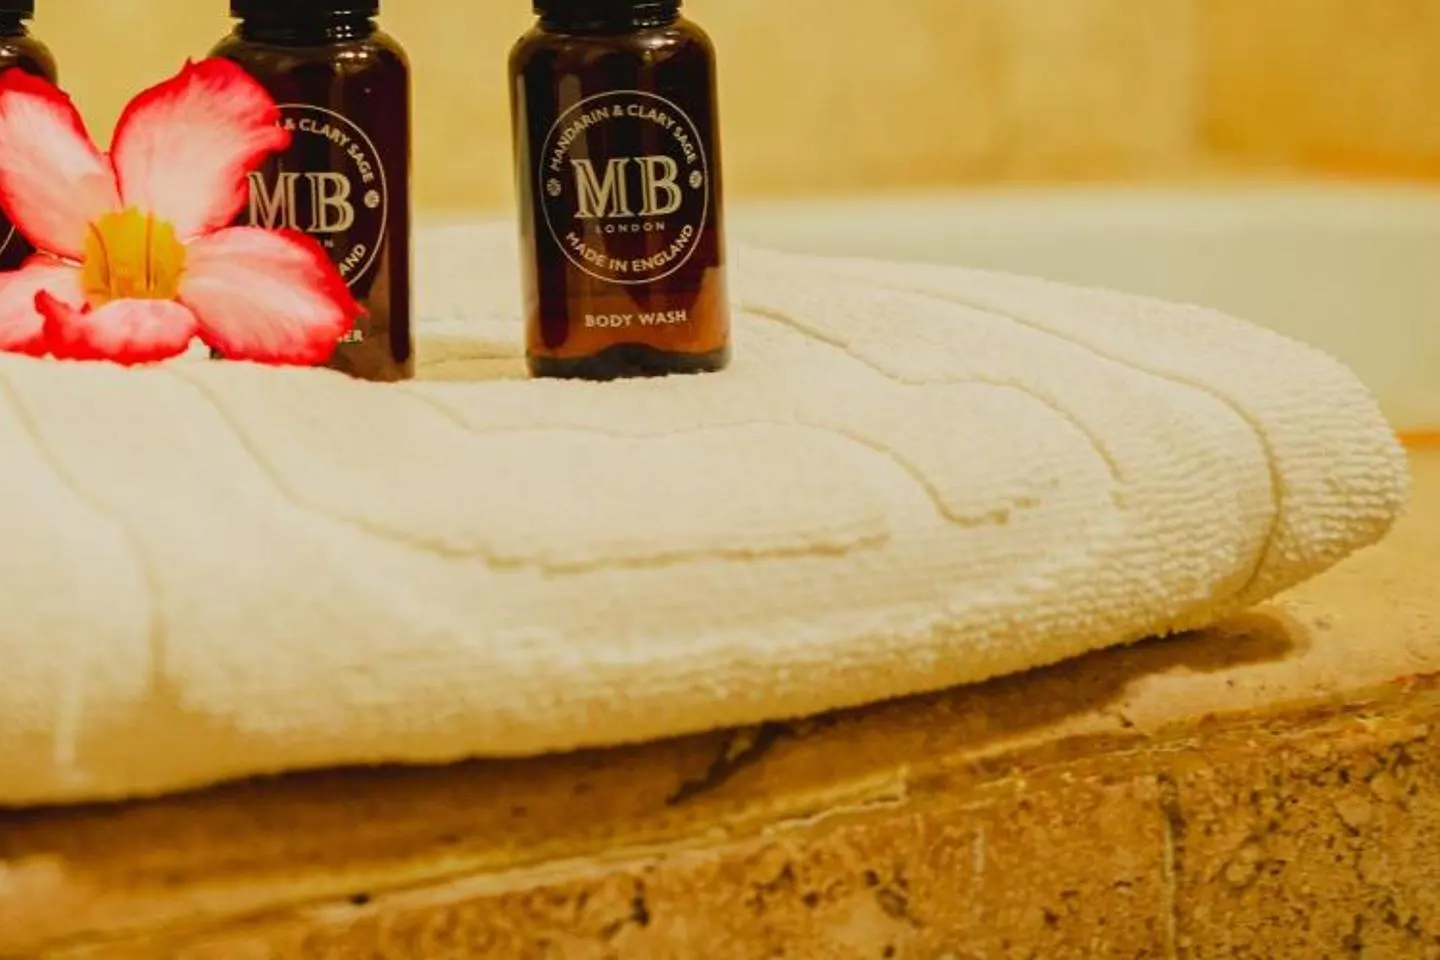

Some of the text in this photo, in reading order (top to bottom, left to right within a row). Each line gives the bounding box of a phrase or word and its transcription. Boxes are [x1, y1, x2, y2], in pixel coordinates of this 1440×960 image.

[284, 118, 375, 184] & CLARY SAGE
[550, 104, 698, 171] MANDARIN & CLARY SAGE
[246, 171, 354, 233] MB
[571, 156, 682, 218] MB
[566, 224, 693, 272] MADE IN ENGLAND
[596, 221, 665, 233] LONDON
[584, 310, 687, 328] BODY WASH
